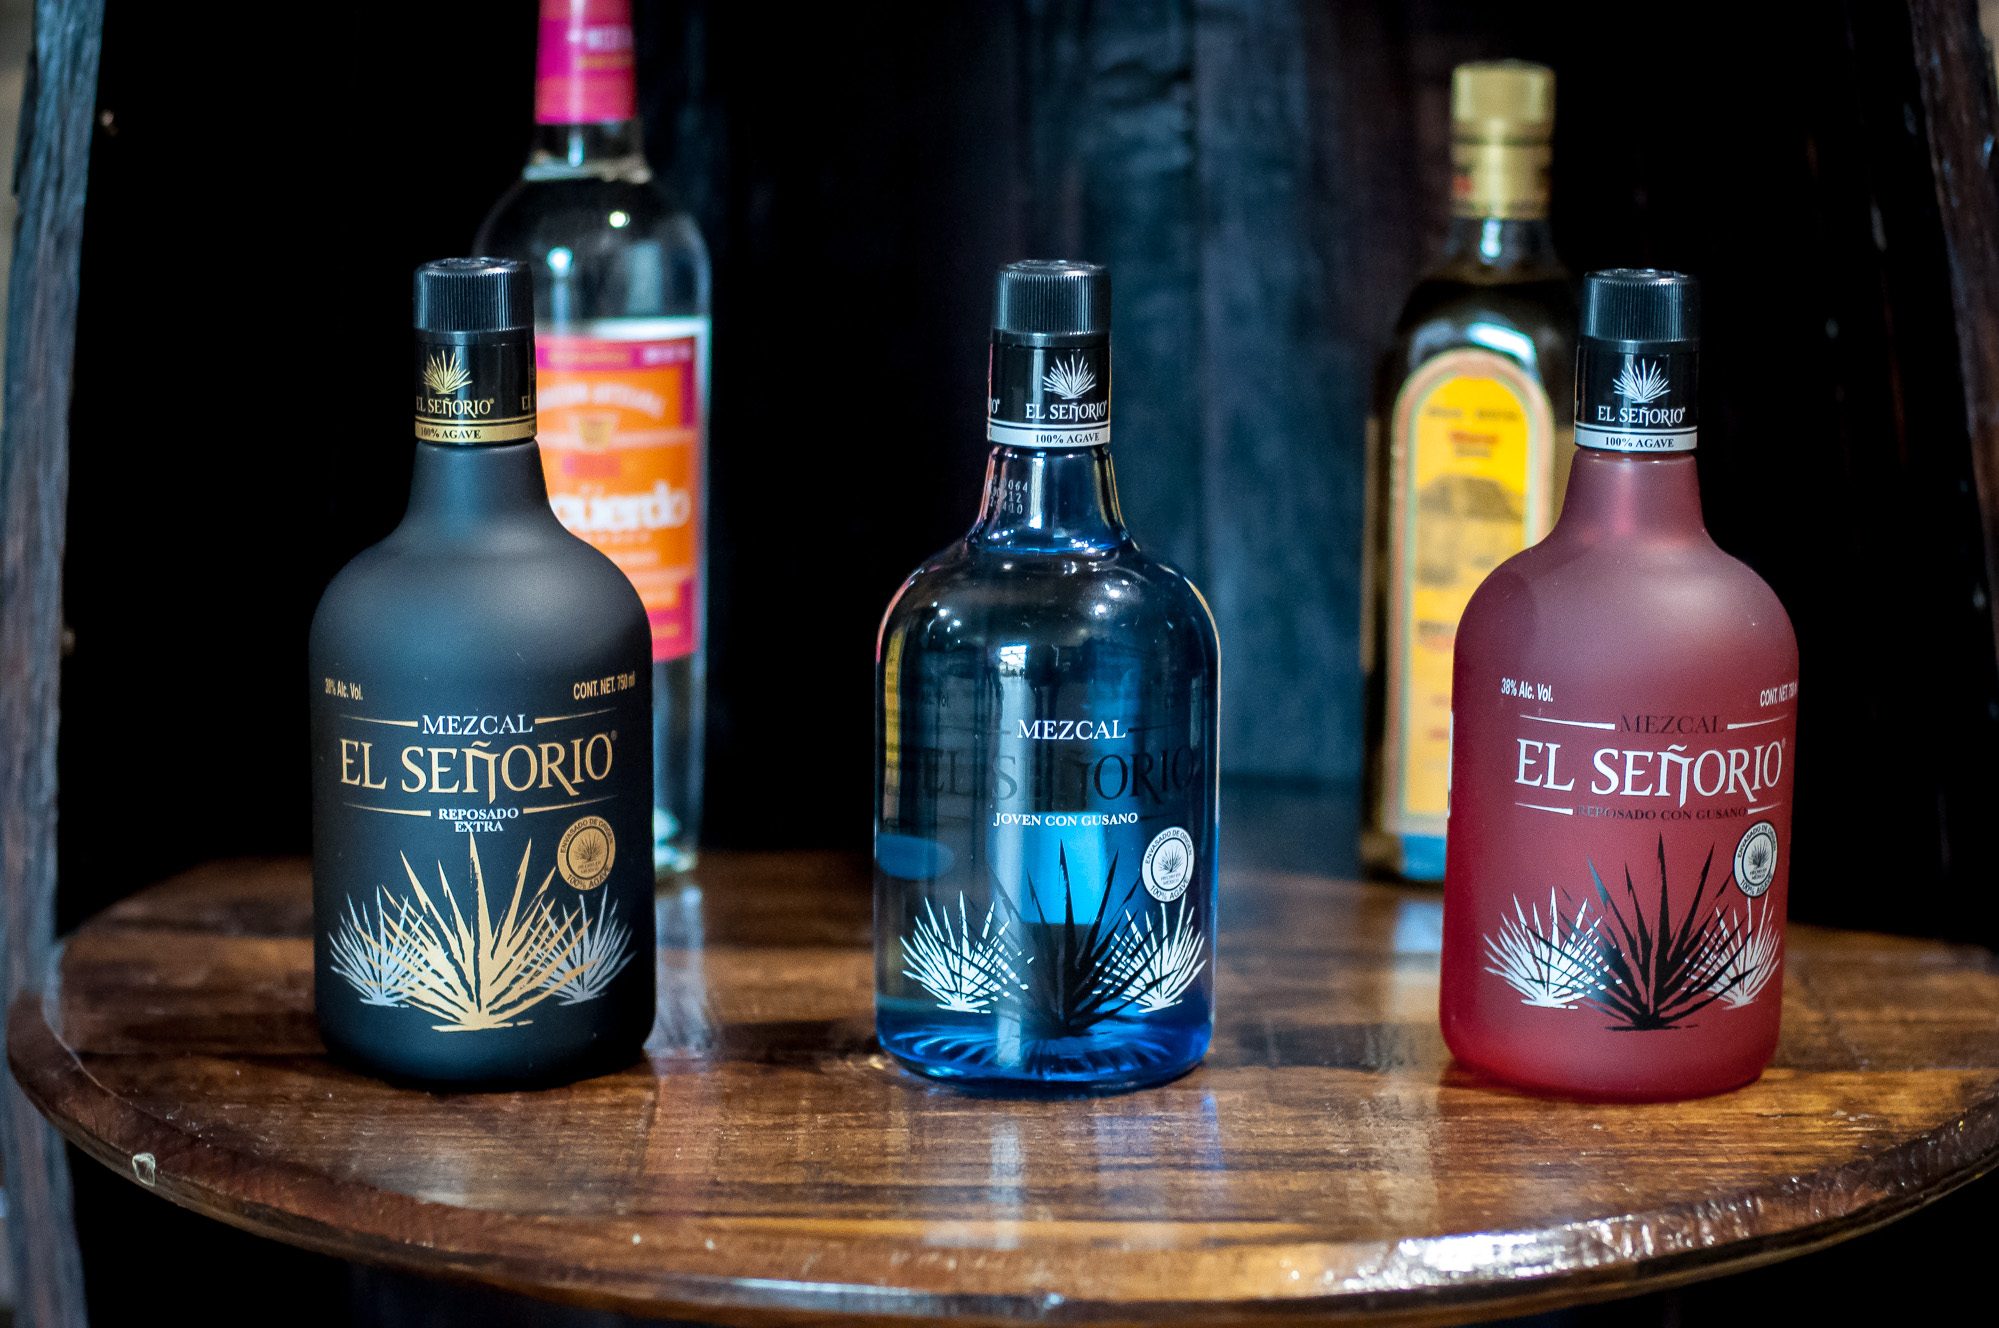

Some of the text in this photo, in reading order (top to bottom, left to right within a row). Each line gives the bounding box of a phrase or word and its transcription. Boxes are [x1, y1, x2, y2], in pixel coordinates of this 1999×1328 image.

[428, 397, 491, 418] SEÑORIO
[1025, 401, 1106, 422] EL SEÑORIO
[1598, 405, 1683, 427] EL SEÑORIO
[442, 429, 481, 439] AGAVE
[1035, 431, 1100, 444] 100% AGAVE
[1605, 436, 1674, 448] 100% AGAVE
[350, 682, 364, 700] Vol.
[573, 680, 599, 700] CONT.
[600, 676, 616, 695] NET.
[1501, 677, 1554, 702] 38% Alc. Vol.
[422, 714, 533, 736] MEZCAL
[1017, 719, 1126, 740] MEZCAL
[1620, 714, 1724, 735] MEZCAL
[339, 733, 614, 804] EL SEÑORIO
[1515, 738, 1783, 808] EL SEÑORIO
[438, 807, 519, 821] REPOSADO
[993, 812, 1139, 827] JOVEN CON GUSANO
[1576, 802, 1748, 820] REPOSADO CON GUSANO
[454, 820, 504, 833] EXTRA
[560, 820, 589, 854] ENVASADO
[589, 818, 599, 826] DE
[1145, 830, 1172, 865] ENVASADO
[1172, 829, 1180, 837] DE
[1150, 885, 1168, 901] 100%
[1169, 876, 1190, 900] AGAVE
